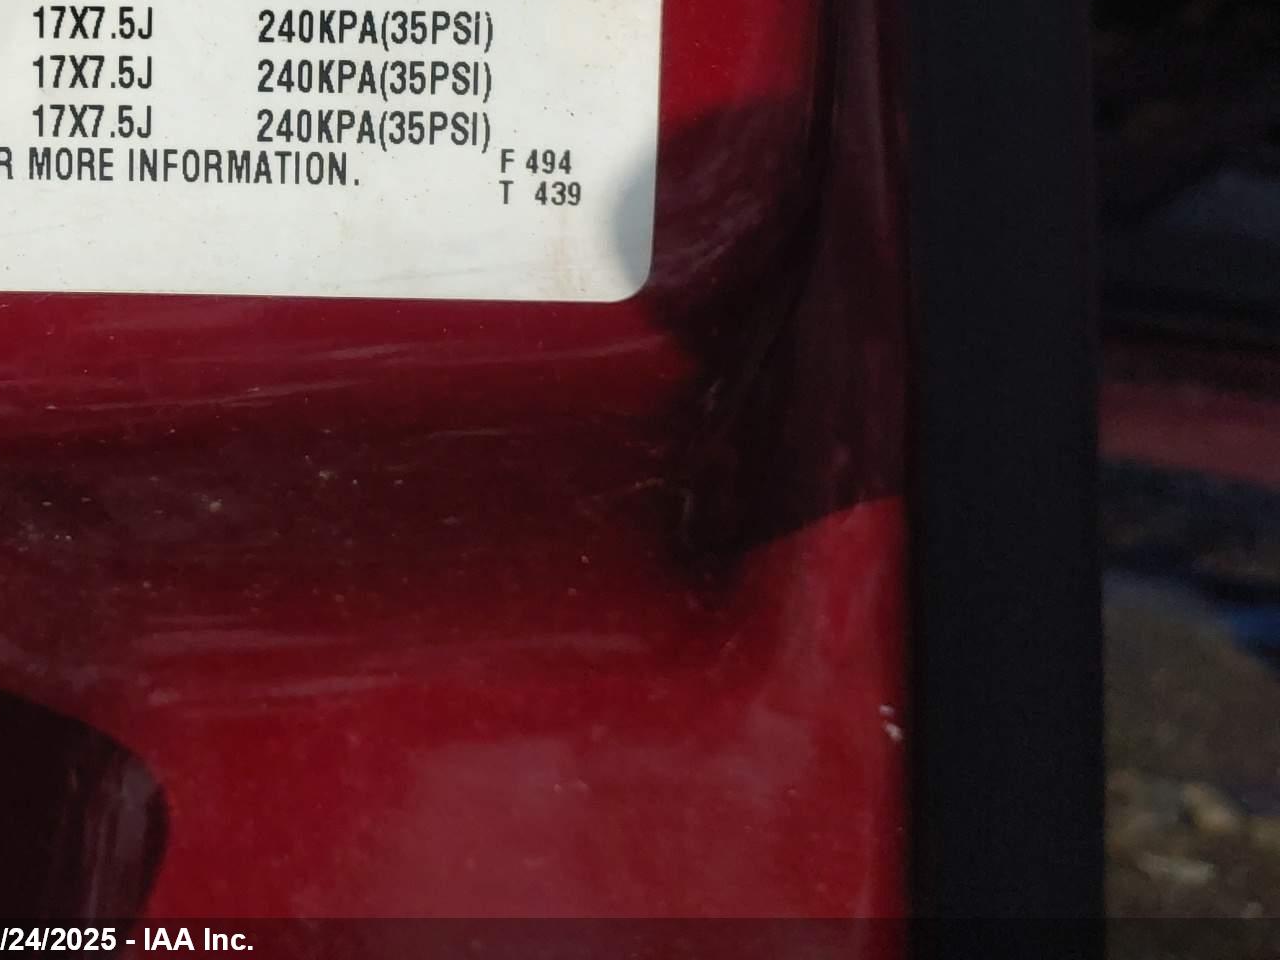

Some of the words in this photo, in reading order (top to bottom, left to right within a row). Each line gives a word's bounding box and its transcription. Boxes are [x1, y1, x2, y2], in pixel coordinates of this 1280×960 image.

[33, 6, 152, 39] 17X7.5J
[259, 9, 493, 53] 240KPA(35PSI)
[33, 55, 152, 89] 17X7.5J
[258, 59, 491, 103] 240KPA(35PSI)
[33, 104, 151, 138] 17X7.5J
[257, 109, 490, 153] 240KPA(35PSI)
[29, 147, 113, 181] MORE
[129, 149, 359, 185] INFORMATION.
[501, 149, 514, 173] F
[526, 149, 571, 174] 494
[499, 180, 513, 204] T
[535, 181, 581, 205] 439
